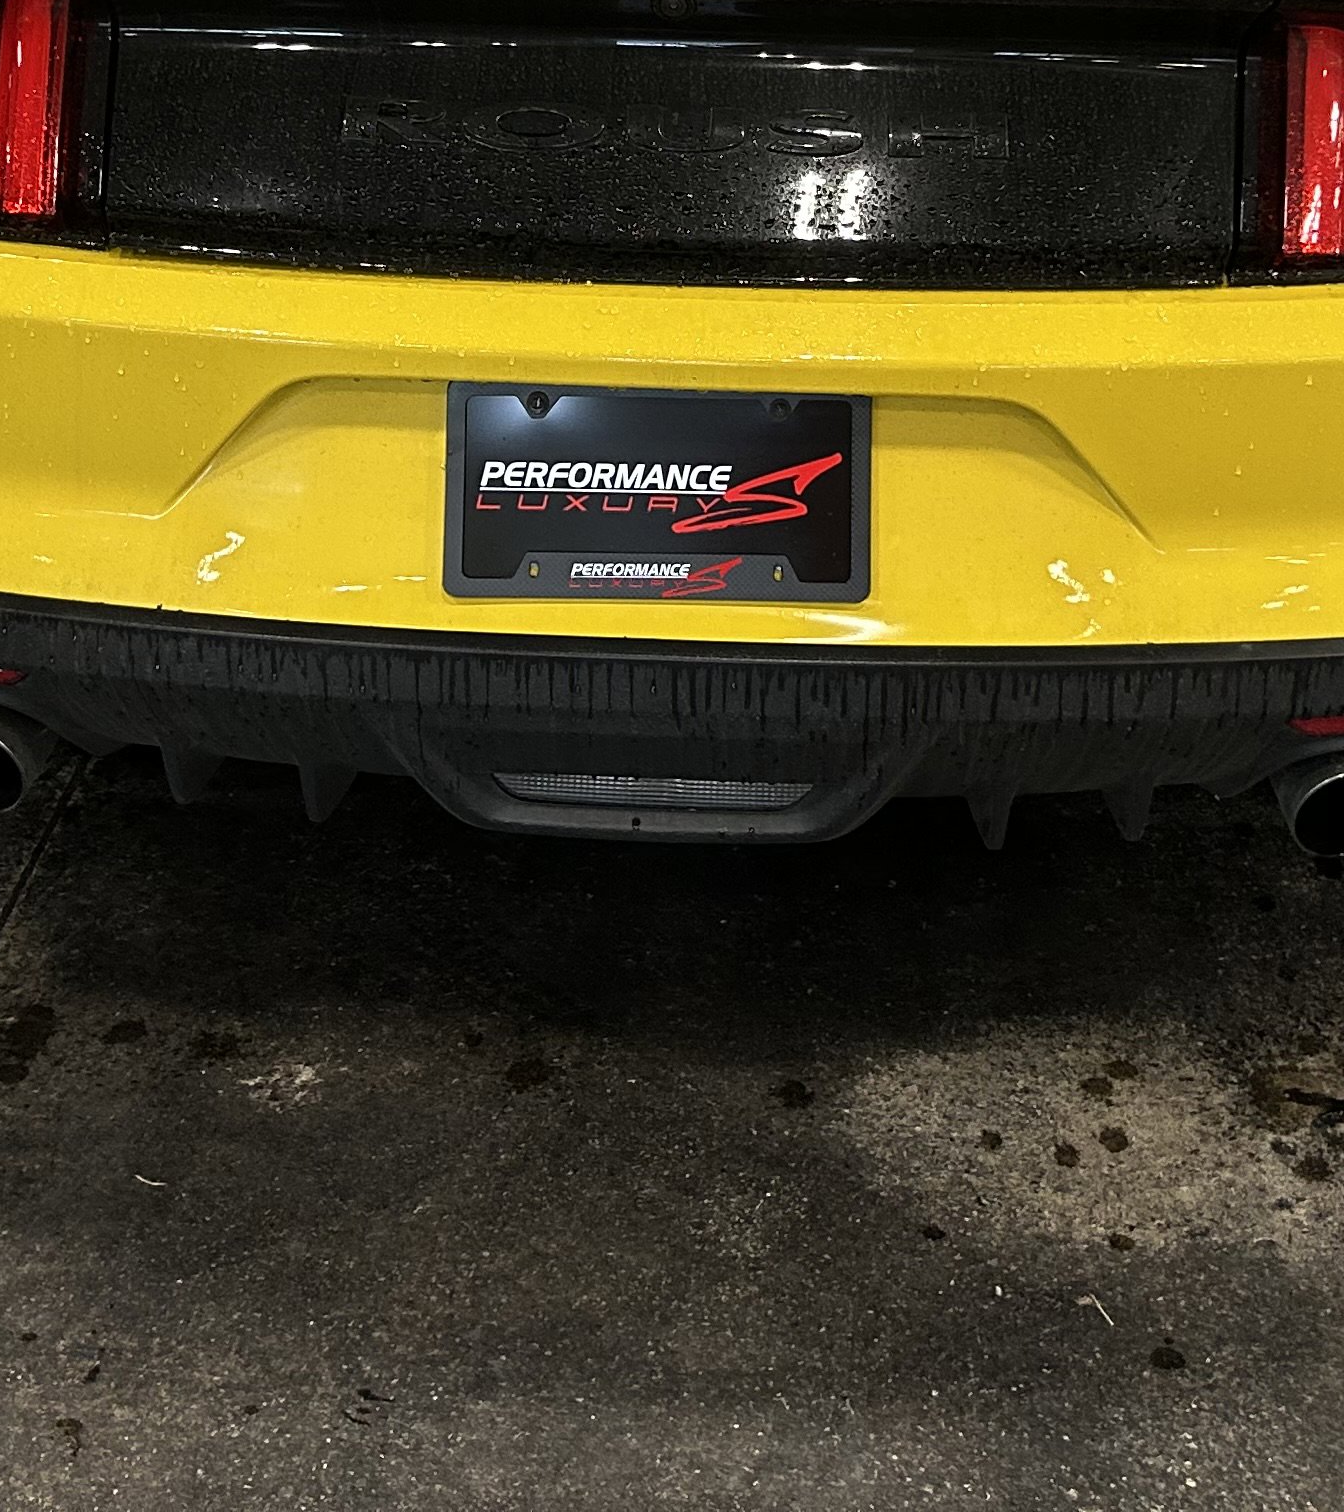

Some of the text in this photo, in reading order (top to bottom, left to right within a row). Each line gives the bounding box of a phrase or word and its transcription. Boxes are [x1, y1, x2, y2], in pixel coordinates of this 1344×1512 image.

[341, 96, 1010, 160] ROUSH
[479, 460, 733, 491] PERFORMANCE
[474, 494, 725, 514] LUXURY
[570, 562, 691, 577] PERFORMANCE
